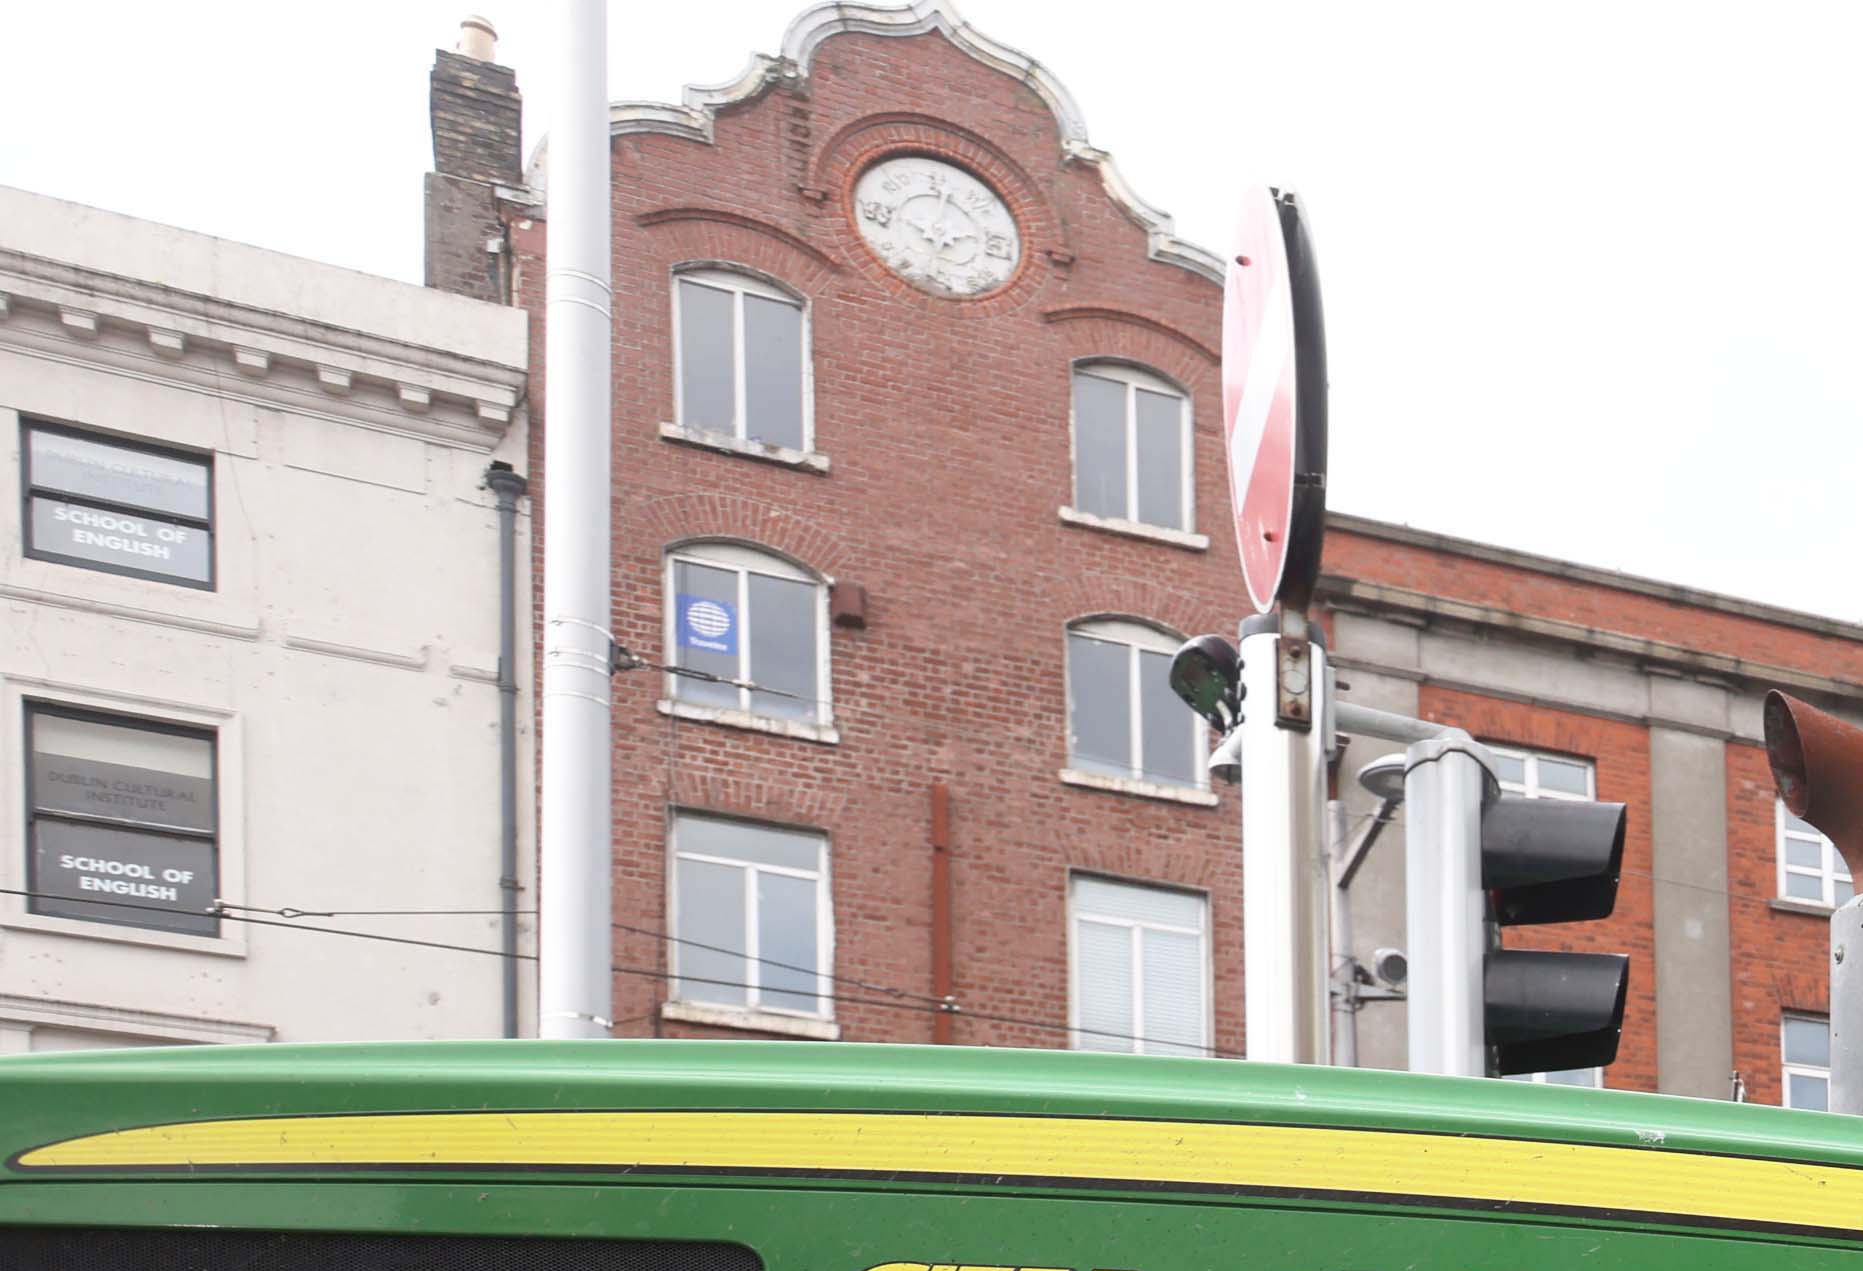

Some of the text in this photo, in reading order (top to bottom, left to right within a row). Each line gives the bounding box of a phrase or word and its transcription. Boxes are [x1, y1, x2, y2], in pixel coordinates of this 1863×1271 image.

[53, 507, 188, 544] SCHOOL OF
[72, 529, 171, 560] ENGLISH
[60, 854, 194, 885] SCHOOL OF
[79, 875, 177, 902] ENGLISH
